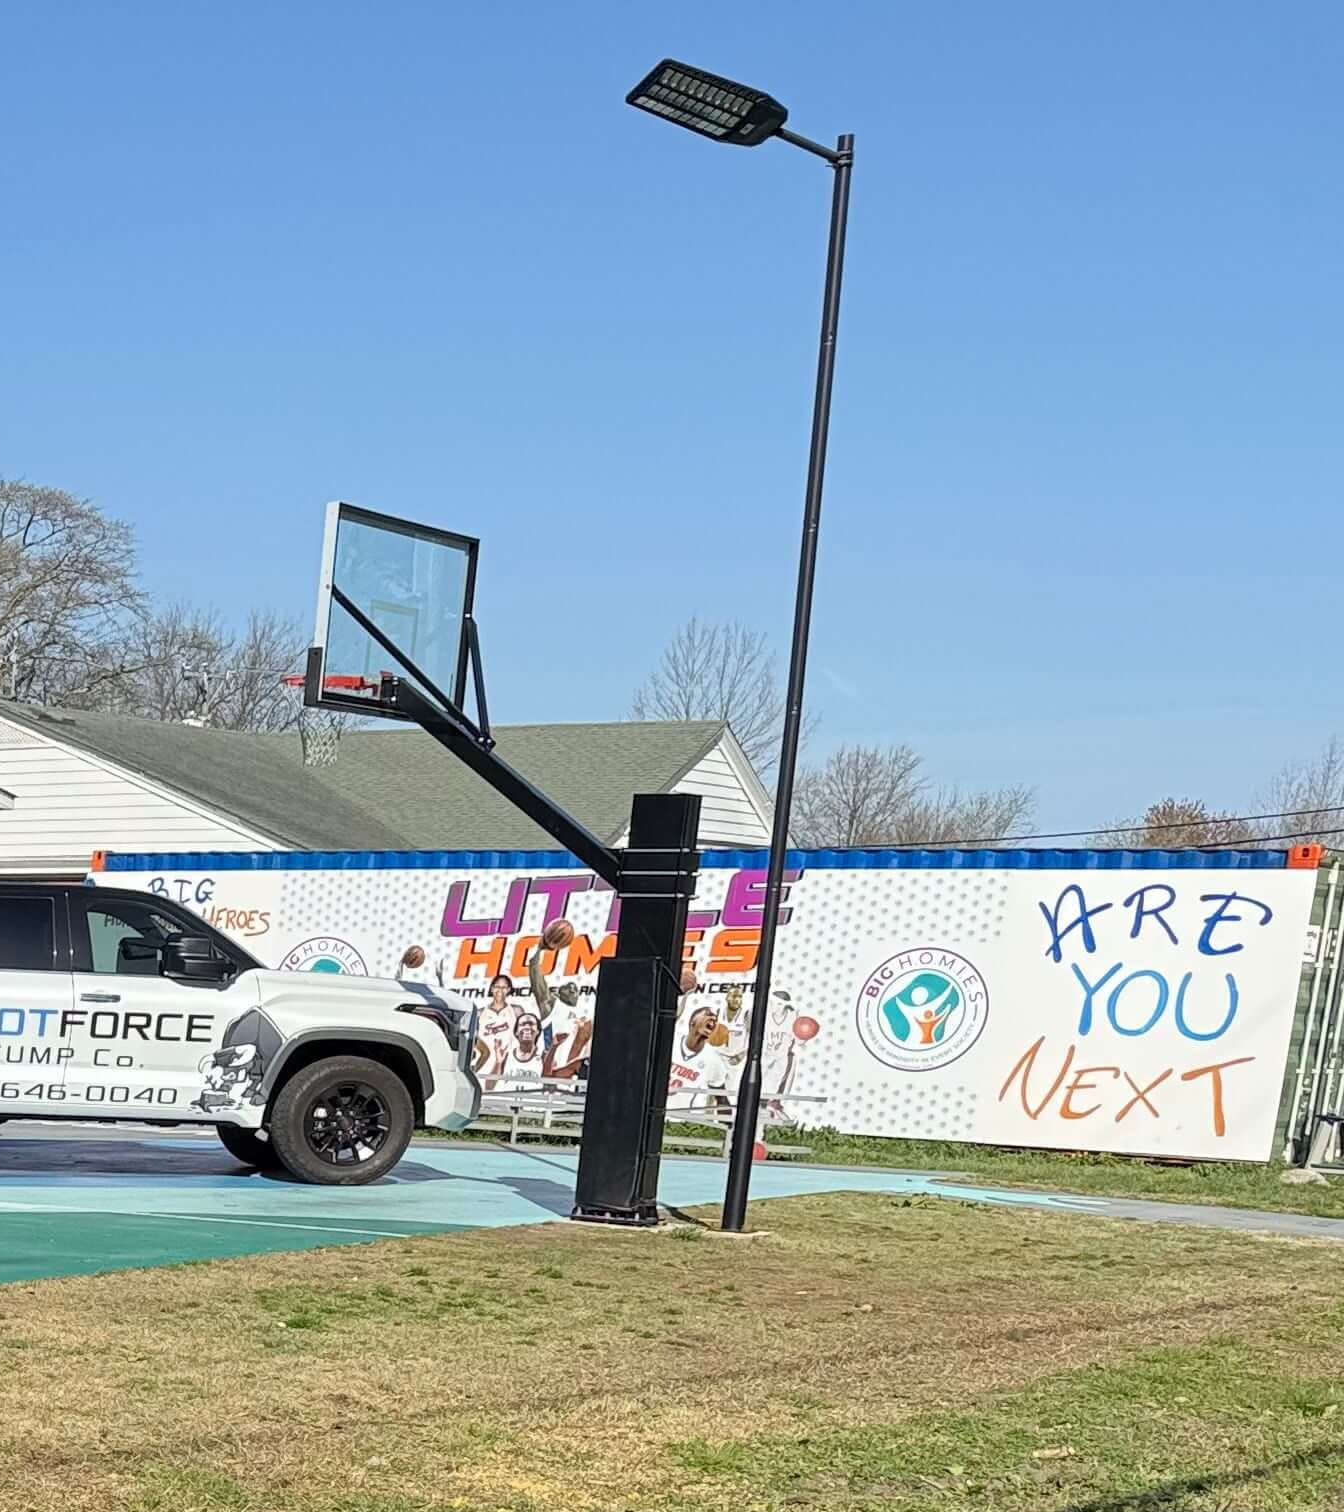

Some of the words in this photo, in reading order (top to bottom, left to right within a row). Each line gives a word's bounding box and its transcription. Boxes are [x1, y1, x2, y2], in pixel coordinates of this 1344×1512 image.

[147, 877, 216, 903] BIG
[441, 869, 804, 937] LITE
[1039, 884, 1273, 963] ARE
[453, 928, 762, 979] HOMS
[866, 967, 894, 998] BIG
[1071, 962, 1239, 1041] YOU
[93, 1048, 144, 1069] Co.
[999, 1035, 1256, 1137] NEXT
